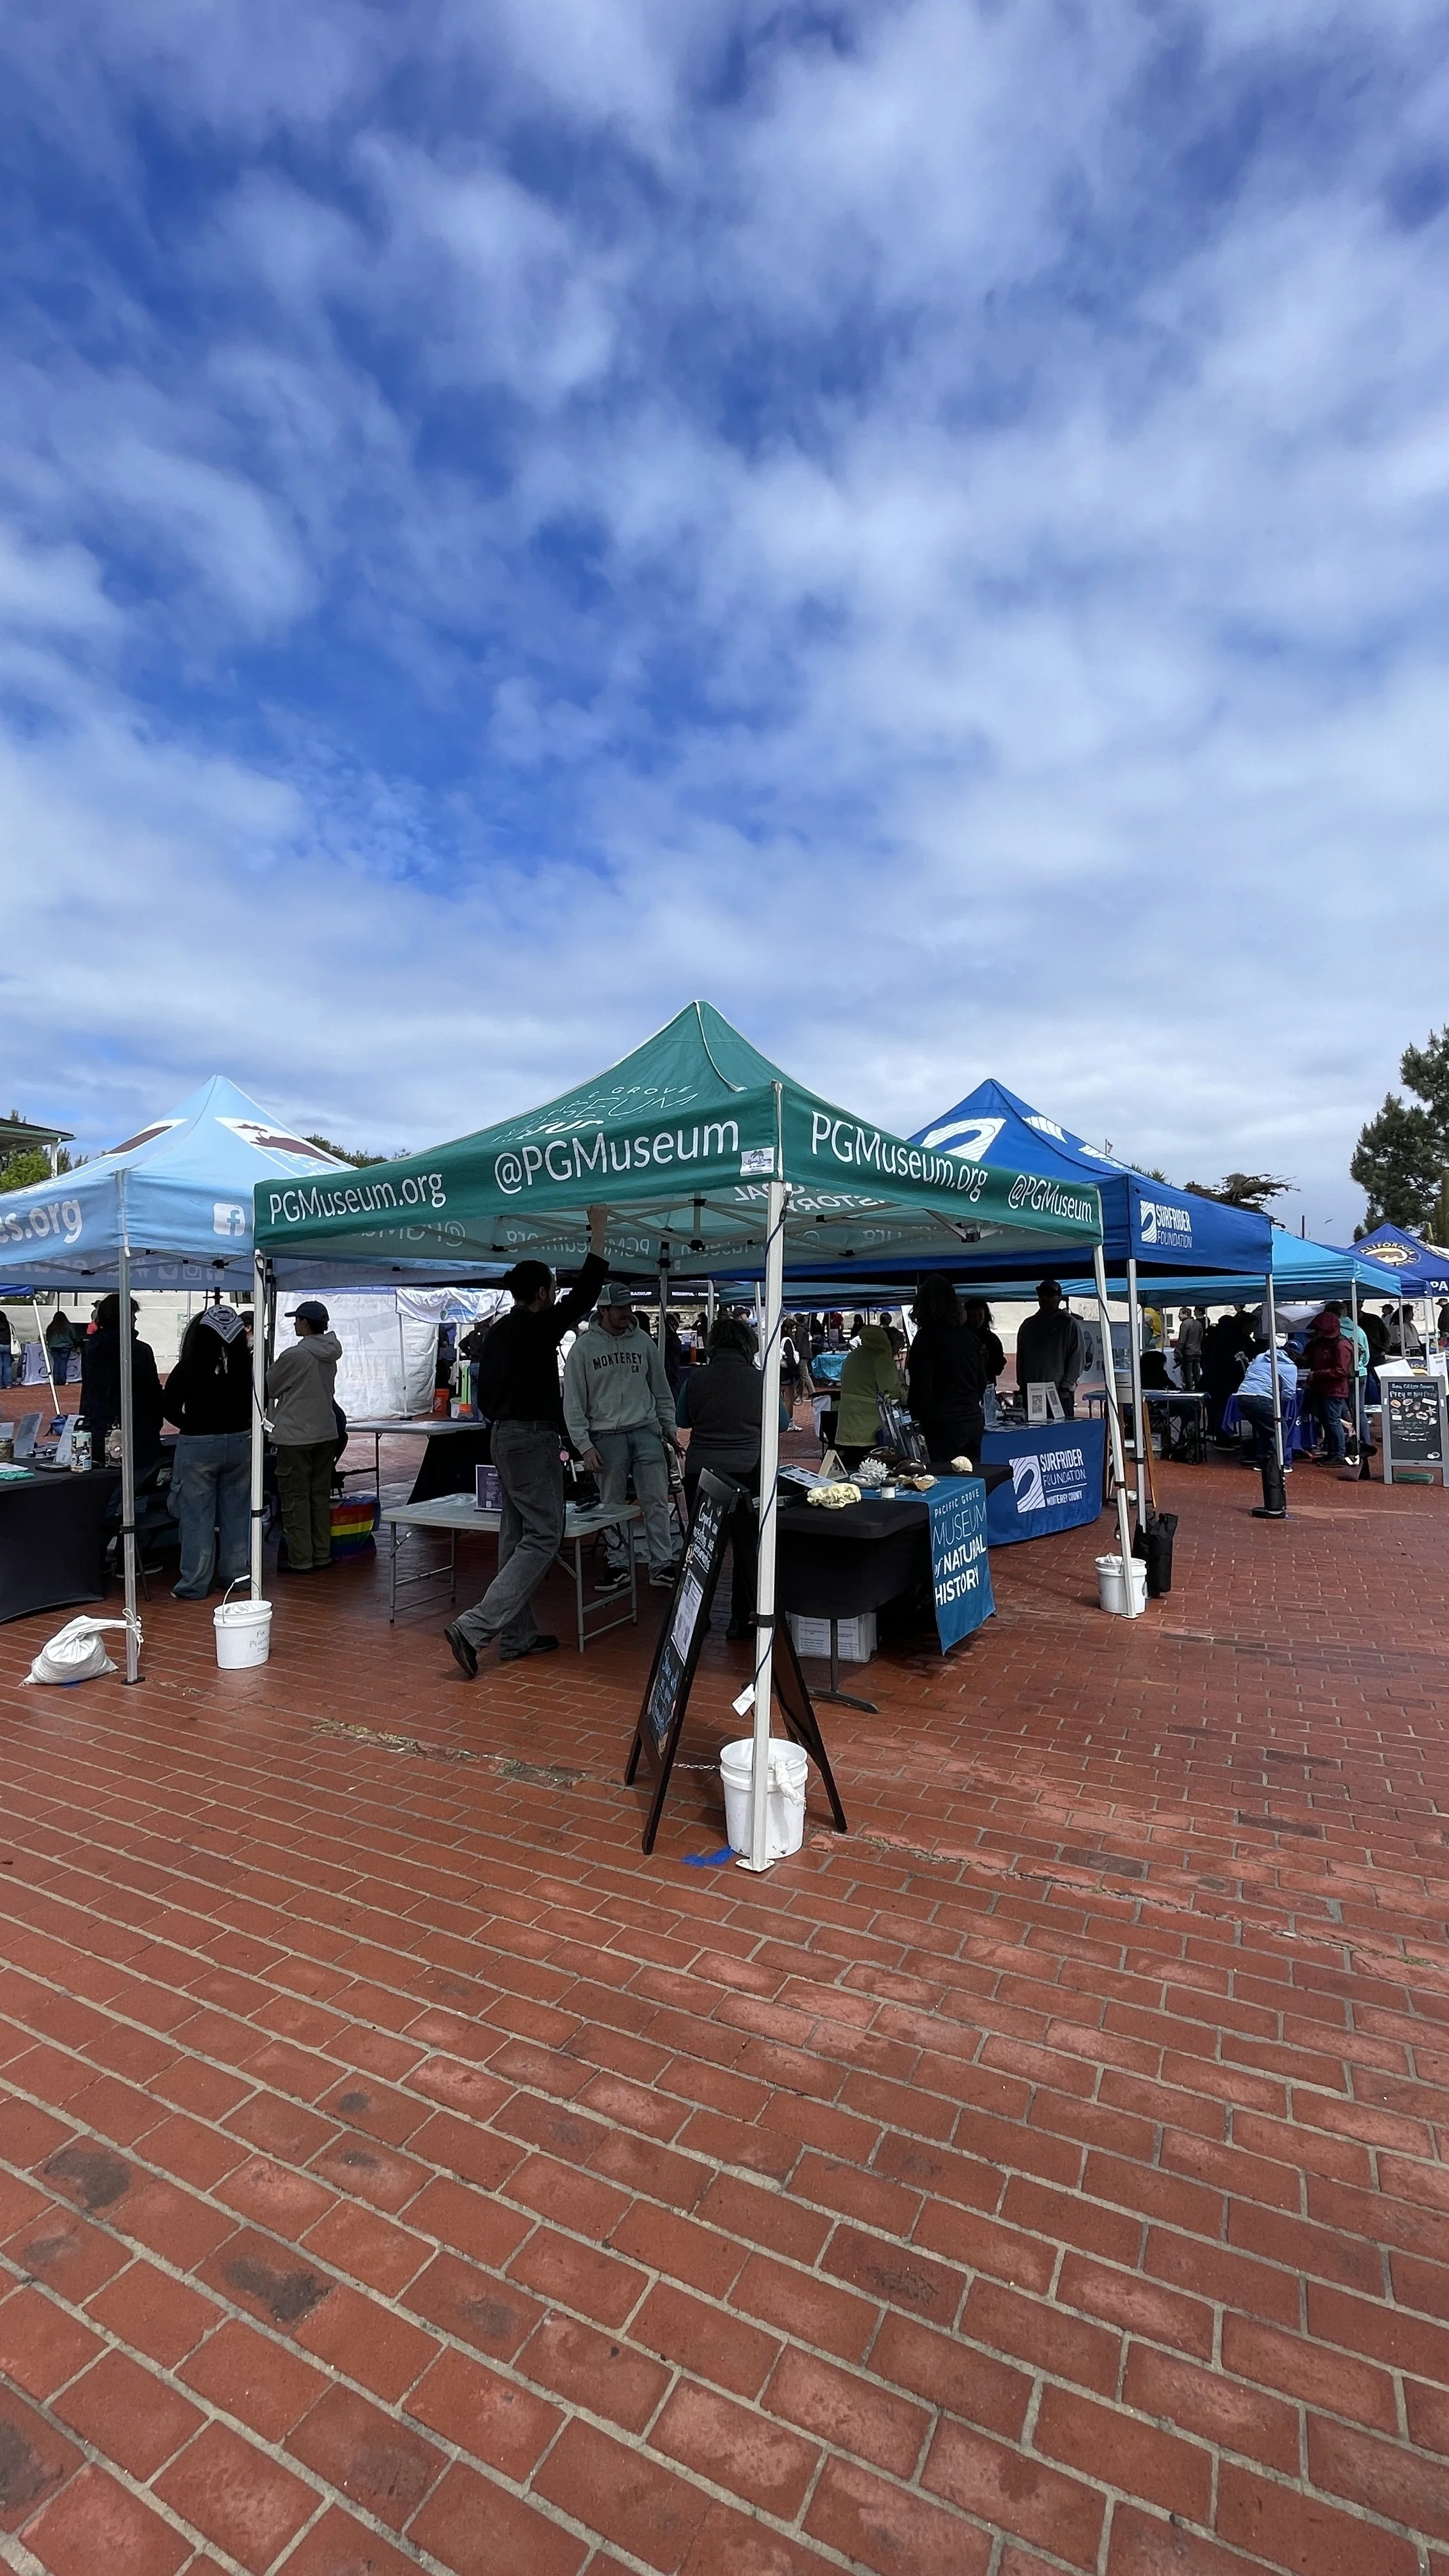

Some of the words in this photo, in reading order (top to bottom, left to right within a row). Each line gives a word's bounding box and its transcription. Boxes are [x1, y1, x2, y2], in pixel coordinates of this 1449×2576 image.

[494, 1120, 739, 1194] @PGMuseum
[811, 1111, 988, 1202] PGMuseum.org
[269, 1173, 447, 1225] PGMuseum.org
[1008, 1174, 1092, 1223] @PGMuseum
[1156, 1204, 1192, 1232] SURFRIDER
[1156, 1230, 1192, 1248] FOUNDATION
[1360, 1243, 1416, 1255] ALIFORNIA
[592, 1352, 642, 1370] MONTEREY
[631, 1365, 639, 1373] CA
[1040, 1448, 1084, 1473] SURFRIDER
[1043, 1468, 1087, 1487] FOUNDATION
[934, 1498, 958, 1519] PACIFIC
[961, 1488, 980, 1505] GROVE
[933, 1501, 987, 1552] MUSEUM
[934, 1557, 944, 1578] of
[943, 1533, 986, 1575] NATURAL
[935, 1565, 979, 1607] HISTORY
